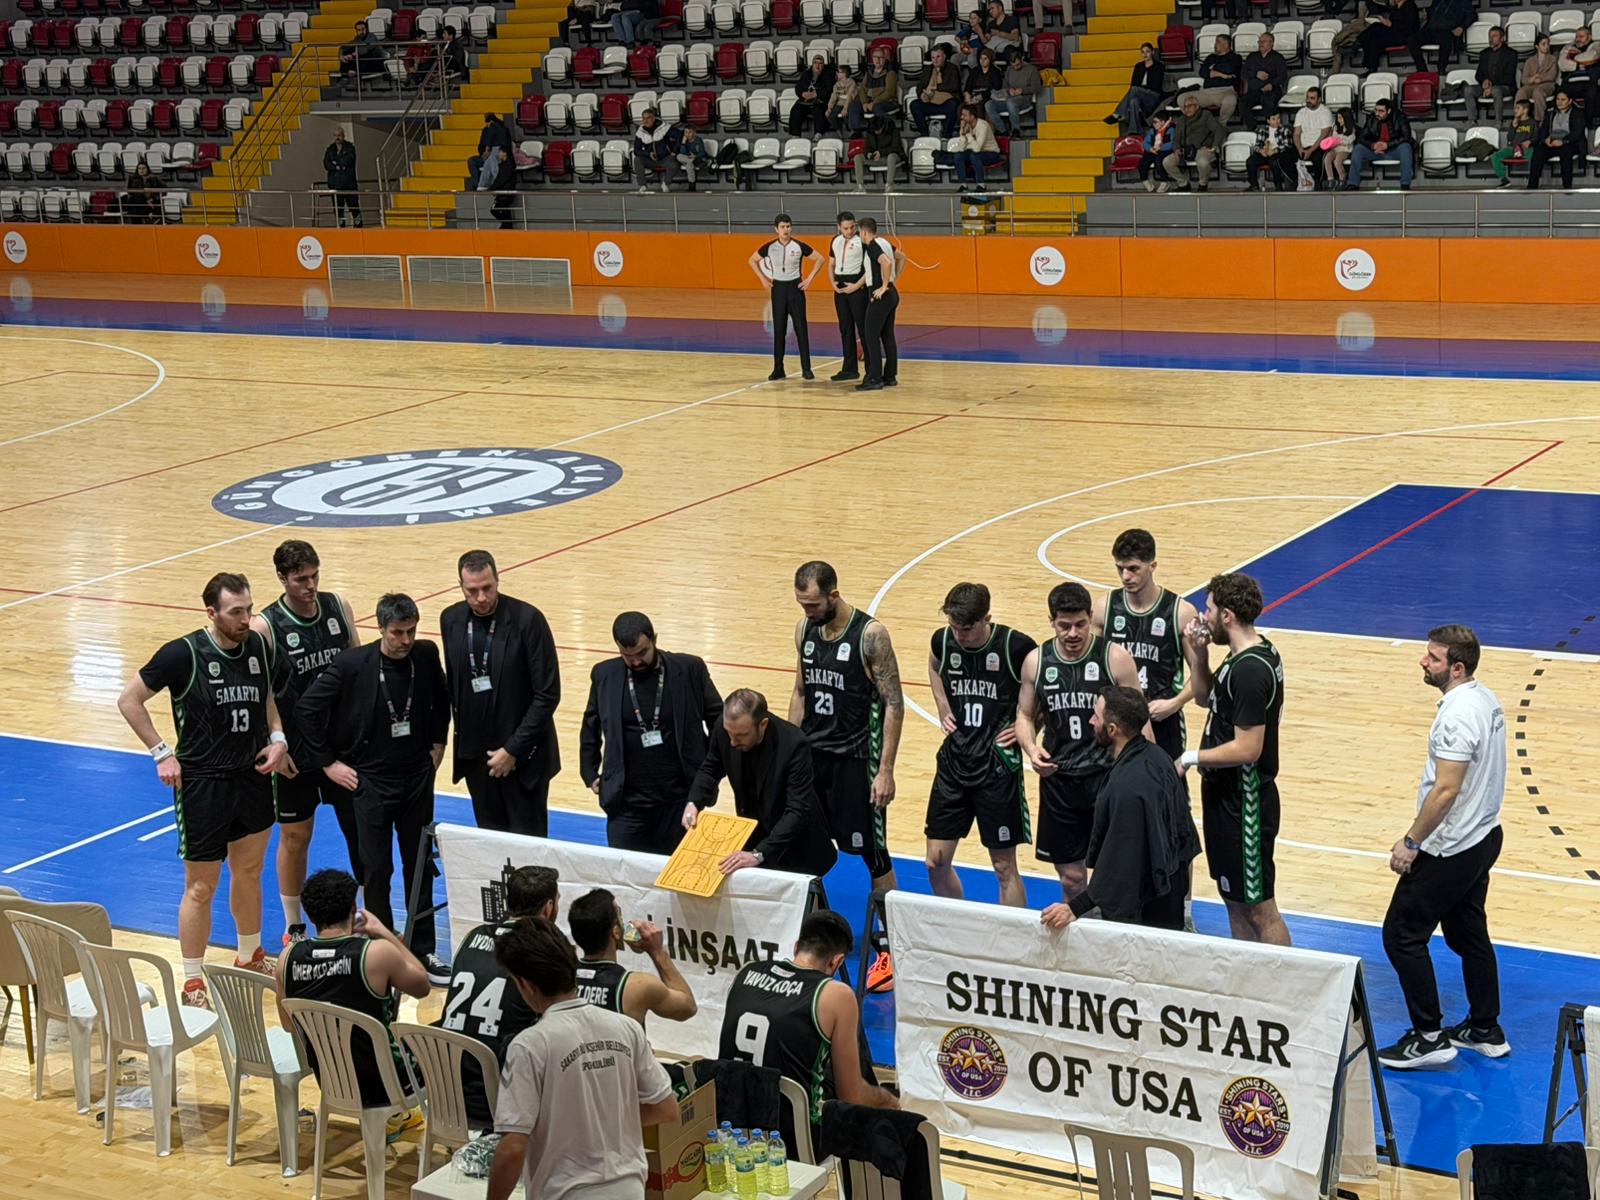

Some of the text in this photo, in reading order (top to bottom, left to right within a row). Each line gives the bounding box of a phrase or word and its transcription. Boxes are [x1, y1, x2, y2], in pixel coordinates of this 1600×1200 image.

[805, 668, 846, 691] SAKARYA
[950, 679, 998, 700] SAKARYA
[215, 685, 260, 705] SAKARYA
[814, 690, 835, 716] 23
[230, 708, 250, 733] 13
[963, 702, 984, 728] 10
[1068, 715, 1082, 740] 8
[666, 916, 780, 976] İNŞAAT
[291, 960, 313, 982] ÖMER
[743, 969, 777, 992] YAVUZ
[441, 971, 508, 1038] 24
[583, 985, 609, 1005] DERE
[945, 970, 1292, 1069] SHINING STAR
[734, 1011, 771, 1068] 9
[943, 1027, 1003, 1058] SHINING STARS
[1028, 1051, 1203, 1123] OF USA
[1225, 1079, 1287, 1113] SHINING STARS
[1242, 1126, 1265, 1138] OF USA
